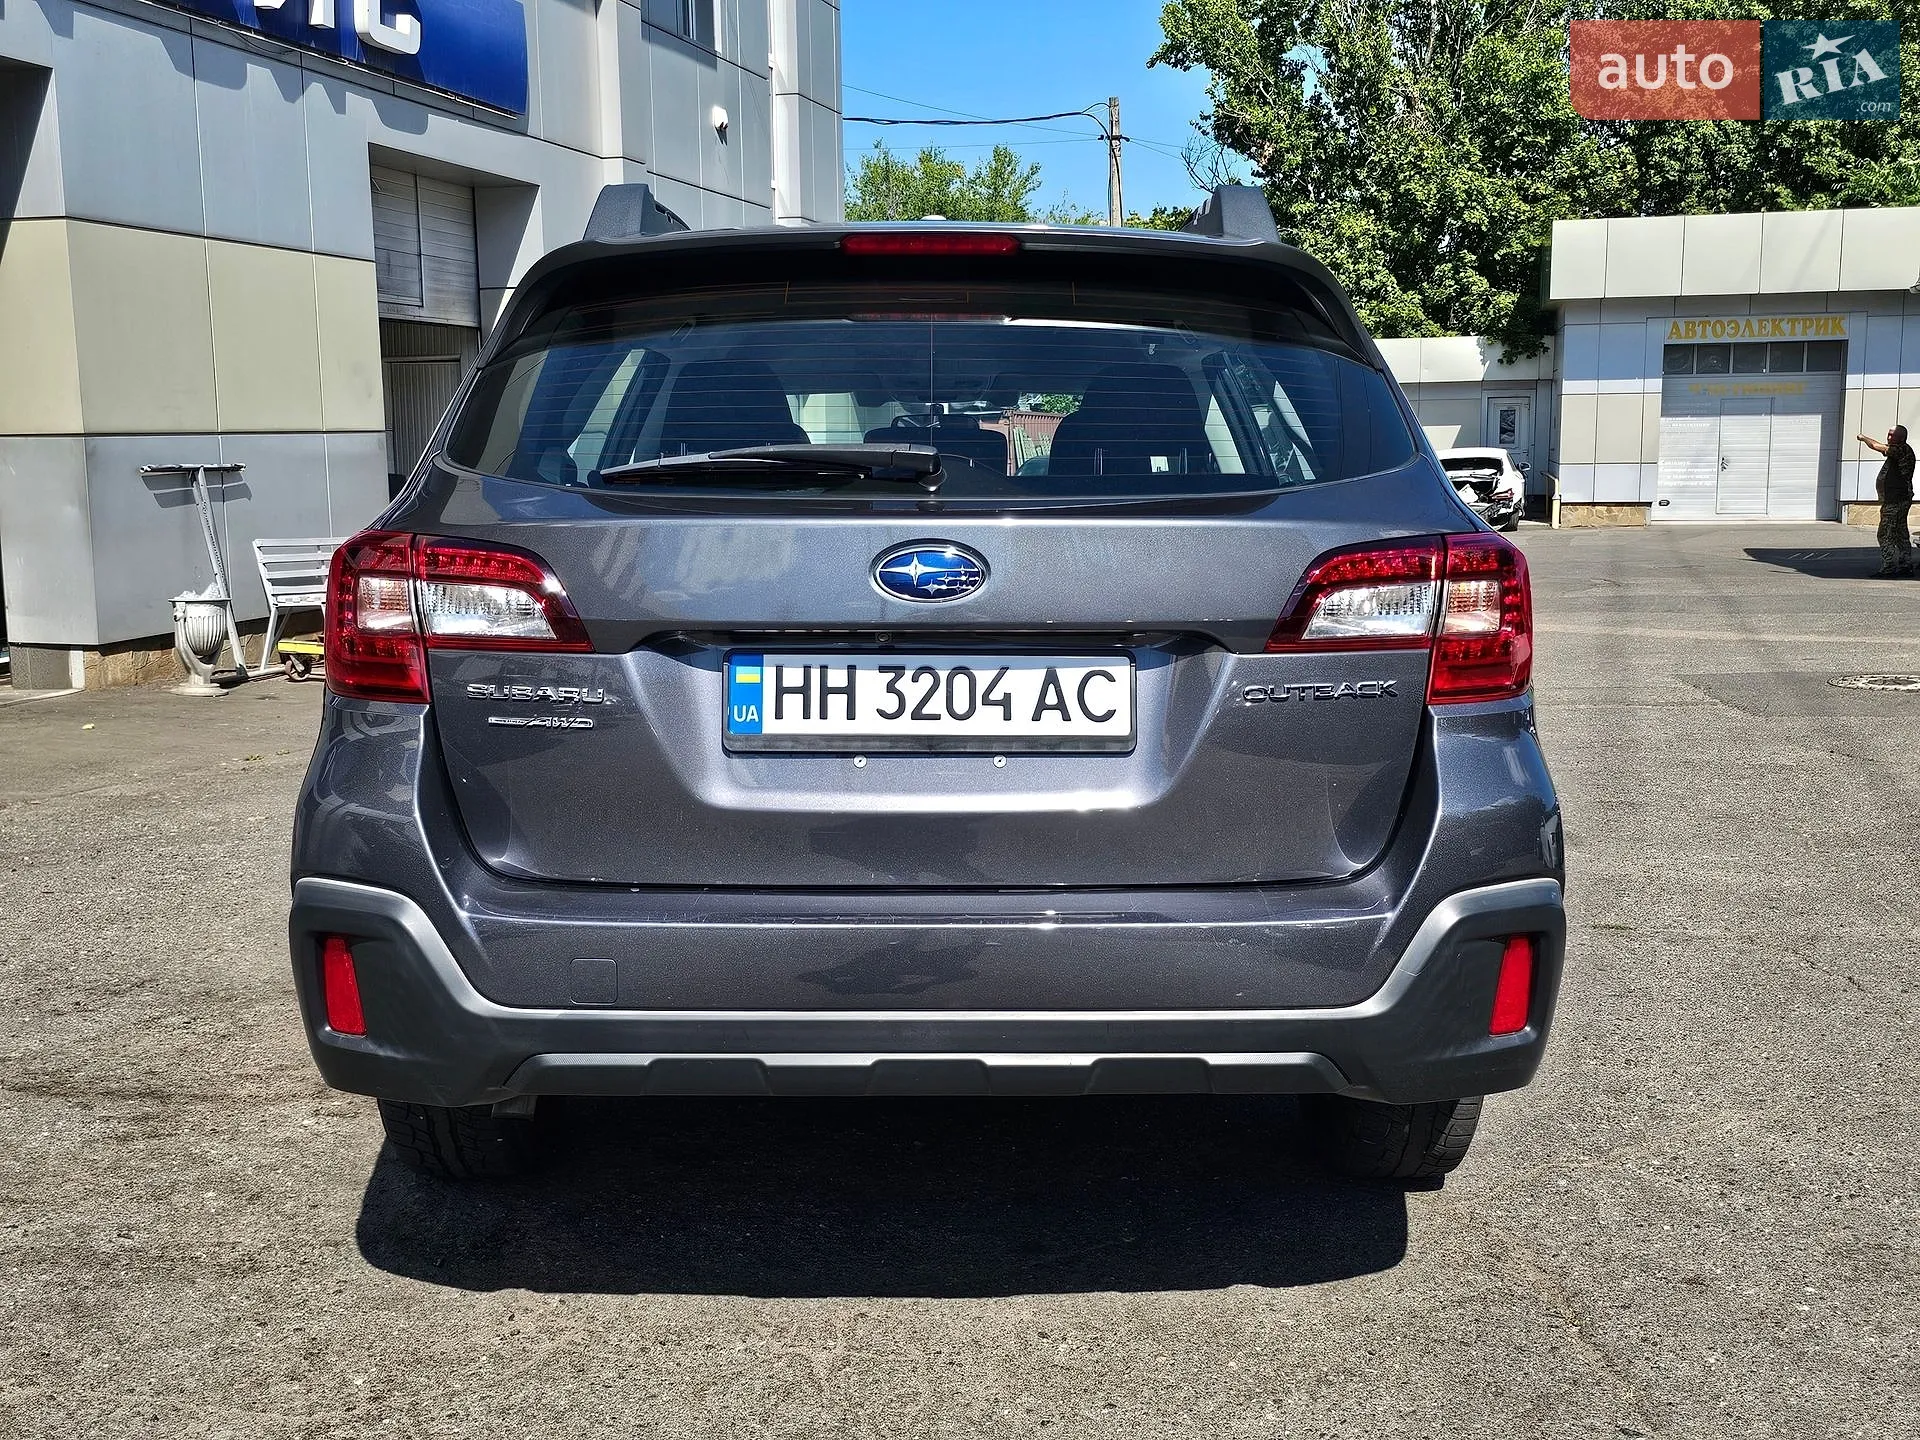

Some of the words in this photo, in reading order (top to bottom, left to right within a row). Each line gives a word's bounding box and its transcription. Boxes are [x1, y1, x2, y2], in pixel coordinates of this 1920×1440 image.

[1667, 316, 1848, 340] АВТОЭЛЕКТРИК
[466, 683, 605, 703] SUBARU
[774, 665, 857, 721] HH
[875, 665, 1013, 722] 3204
[1031, 666, 1118, 723] AC
[1243, 680, 1399, 703] OUTBACK
[733, 704, 759, 723] UA
